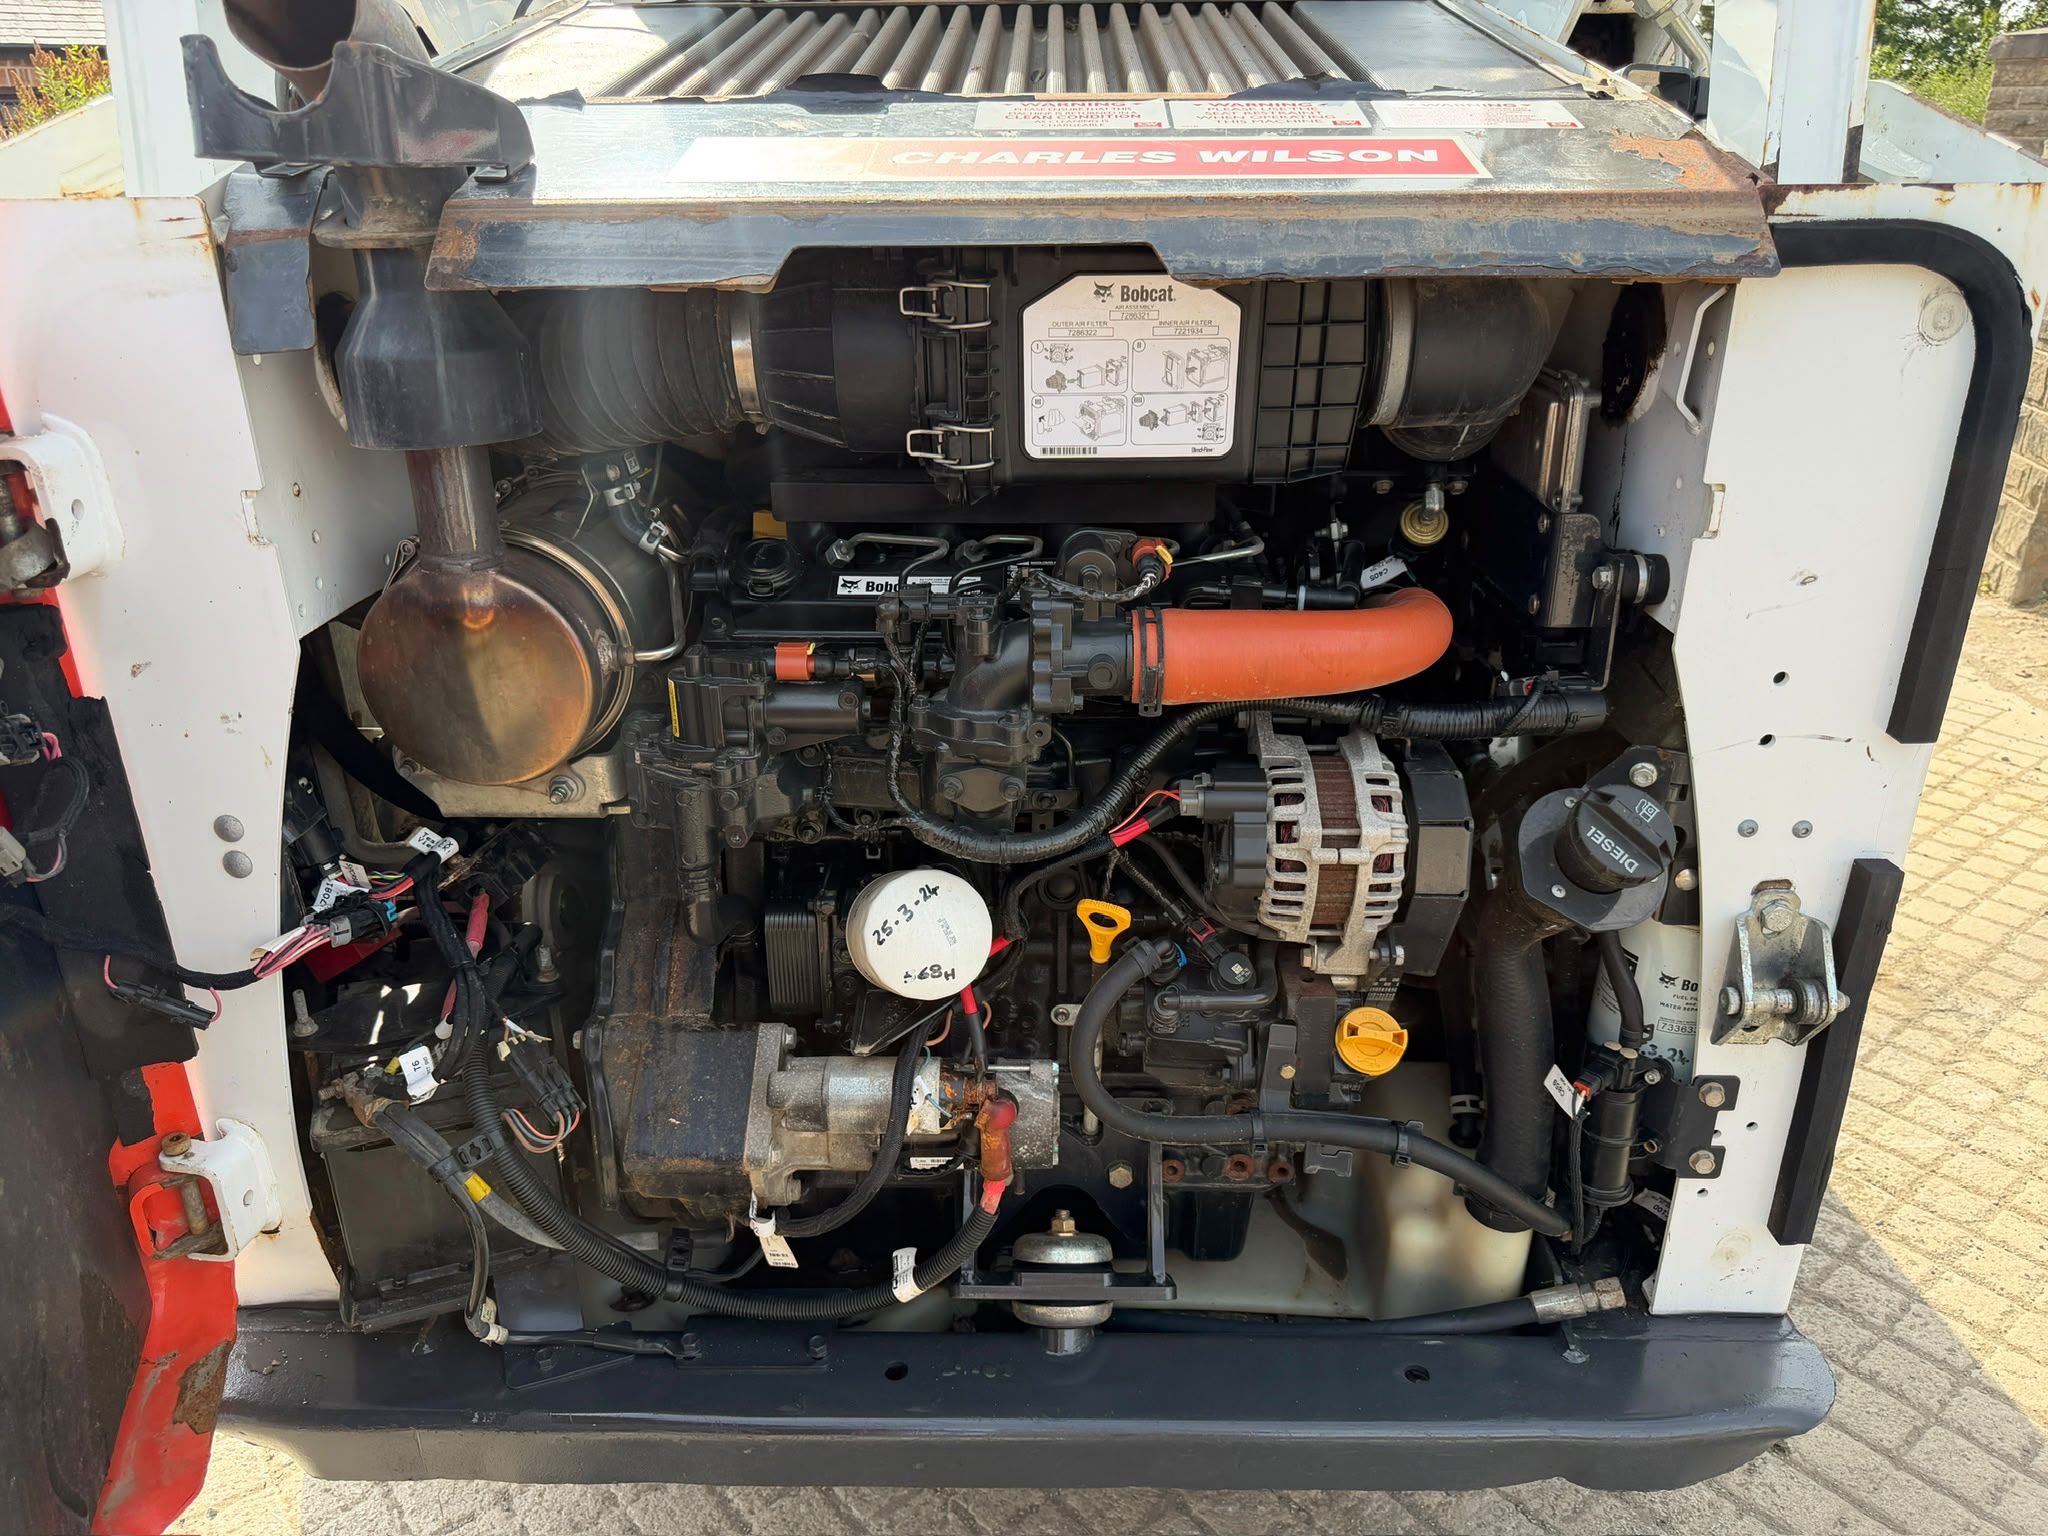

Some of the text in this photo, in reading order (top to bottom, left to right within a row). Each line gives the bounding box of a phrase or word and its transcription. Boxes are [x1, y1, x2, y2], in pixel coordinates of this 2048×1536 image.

[891, 148, 1438, 165] CHARLES WILSON
[1120, 285, 1174, 302] Bobcat
[1369, 568, 1389, 582] C405
[1586, 825, 1639, 874] DIESEL
[1672, 993, 1688, 1001] FUEL
[1659, 1001, 1682, 1011] WATER
